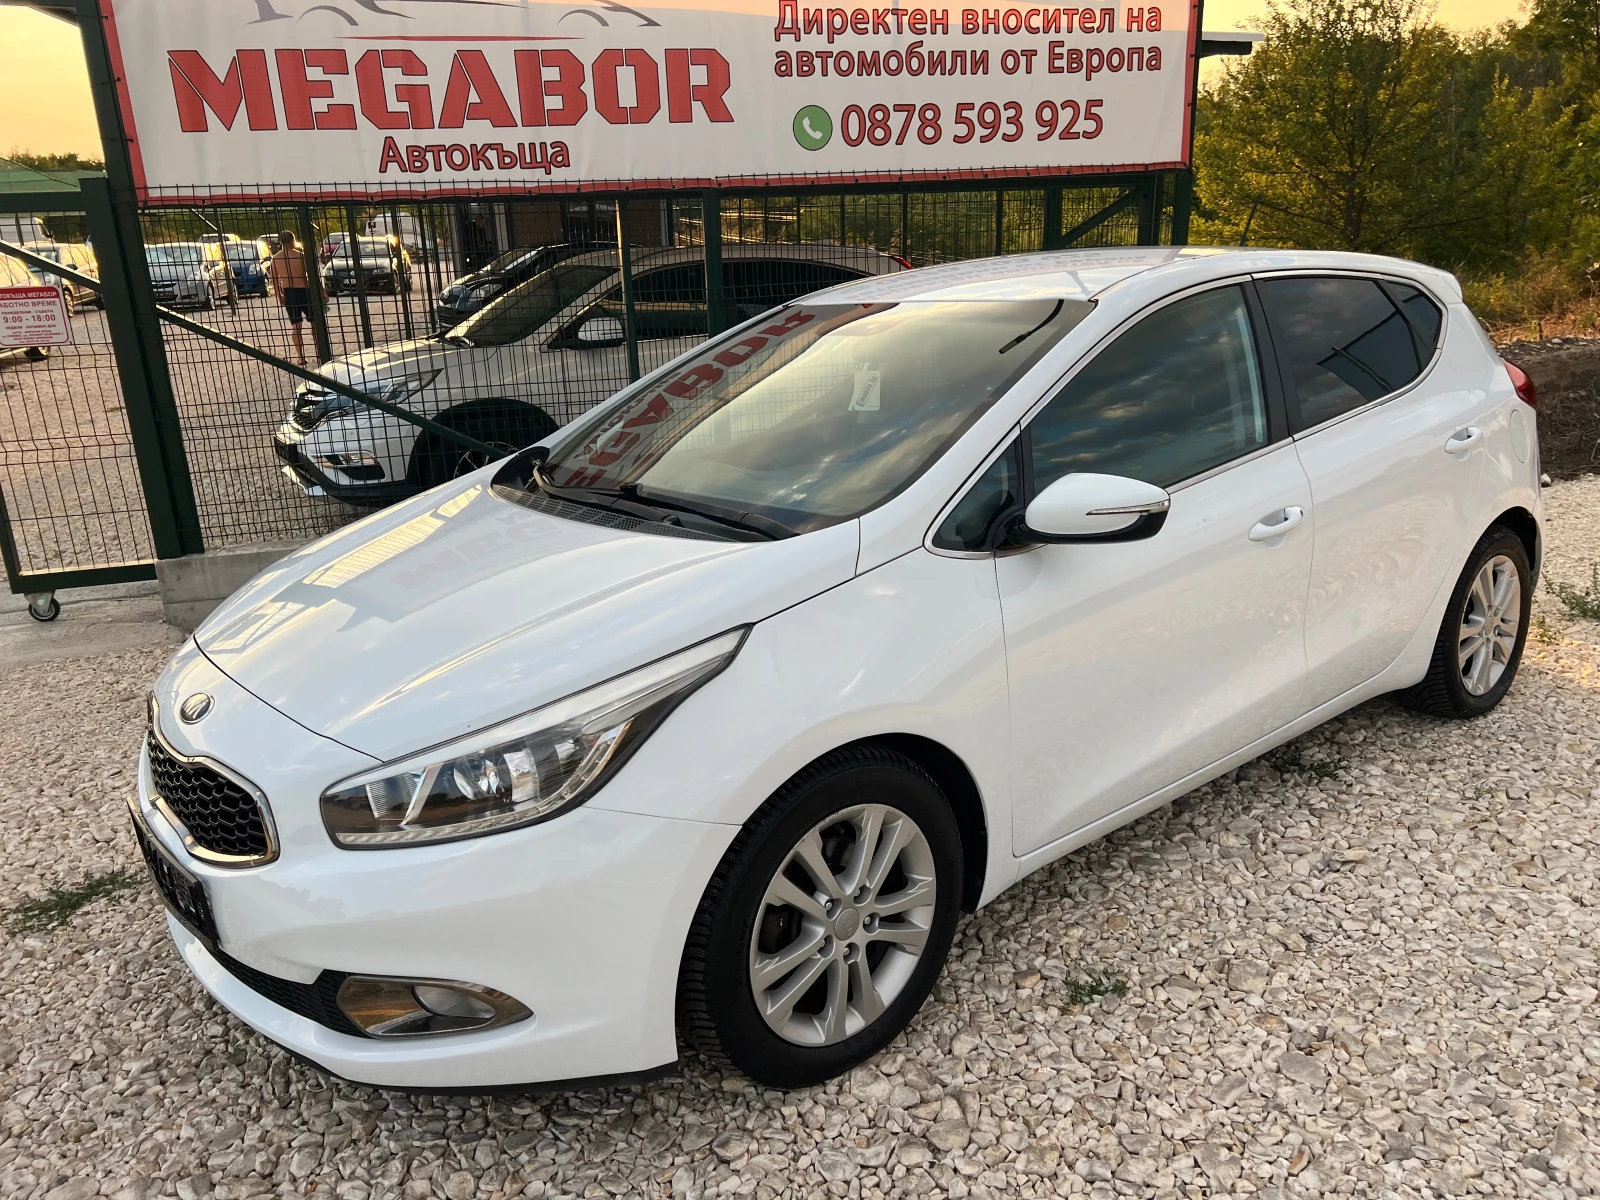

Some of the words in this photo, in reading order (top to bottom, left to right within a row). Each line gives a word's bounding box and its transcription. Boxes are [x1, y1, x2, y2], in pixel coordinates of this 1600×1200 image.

[774, 0, 949, 43] Директен
[961, 3, 1115, 35] вносител
[1126, 4, 1162, 33] на
[774, 41, 989, 77] автомобили
[1000, 47, 1038, 75] от
[1047, 40, 1162, 81] Европа
[167, 49, 735, 132] MEGABOR
[840, 102, 942, 146] 0878
[952, 100, 1024, 145] 593
[1035, 99, 1104, 141] 925
[379, 136, 570, 174] Автокъща
